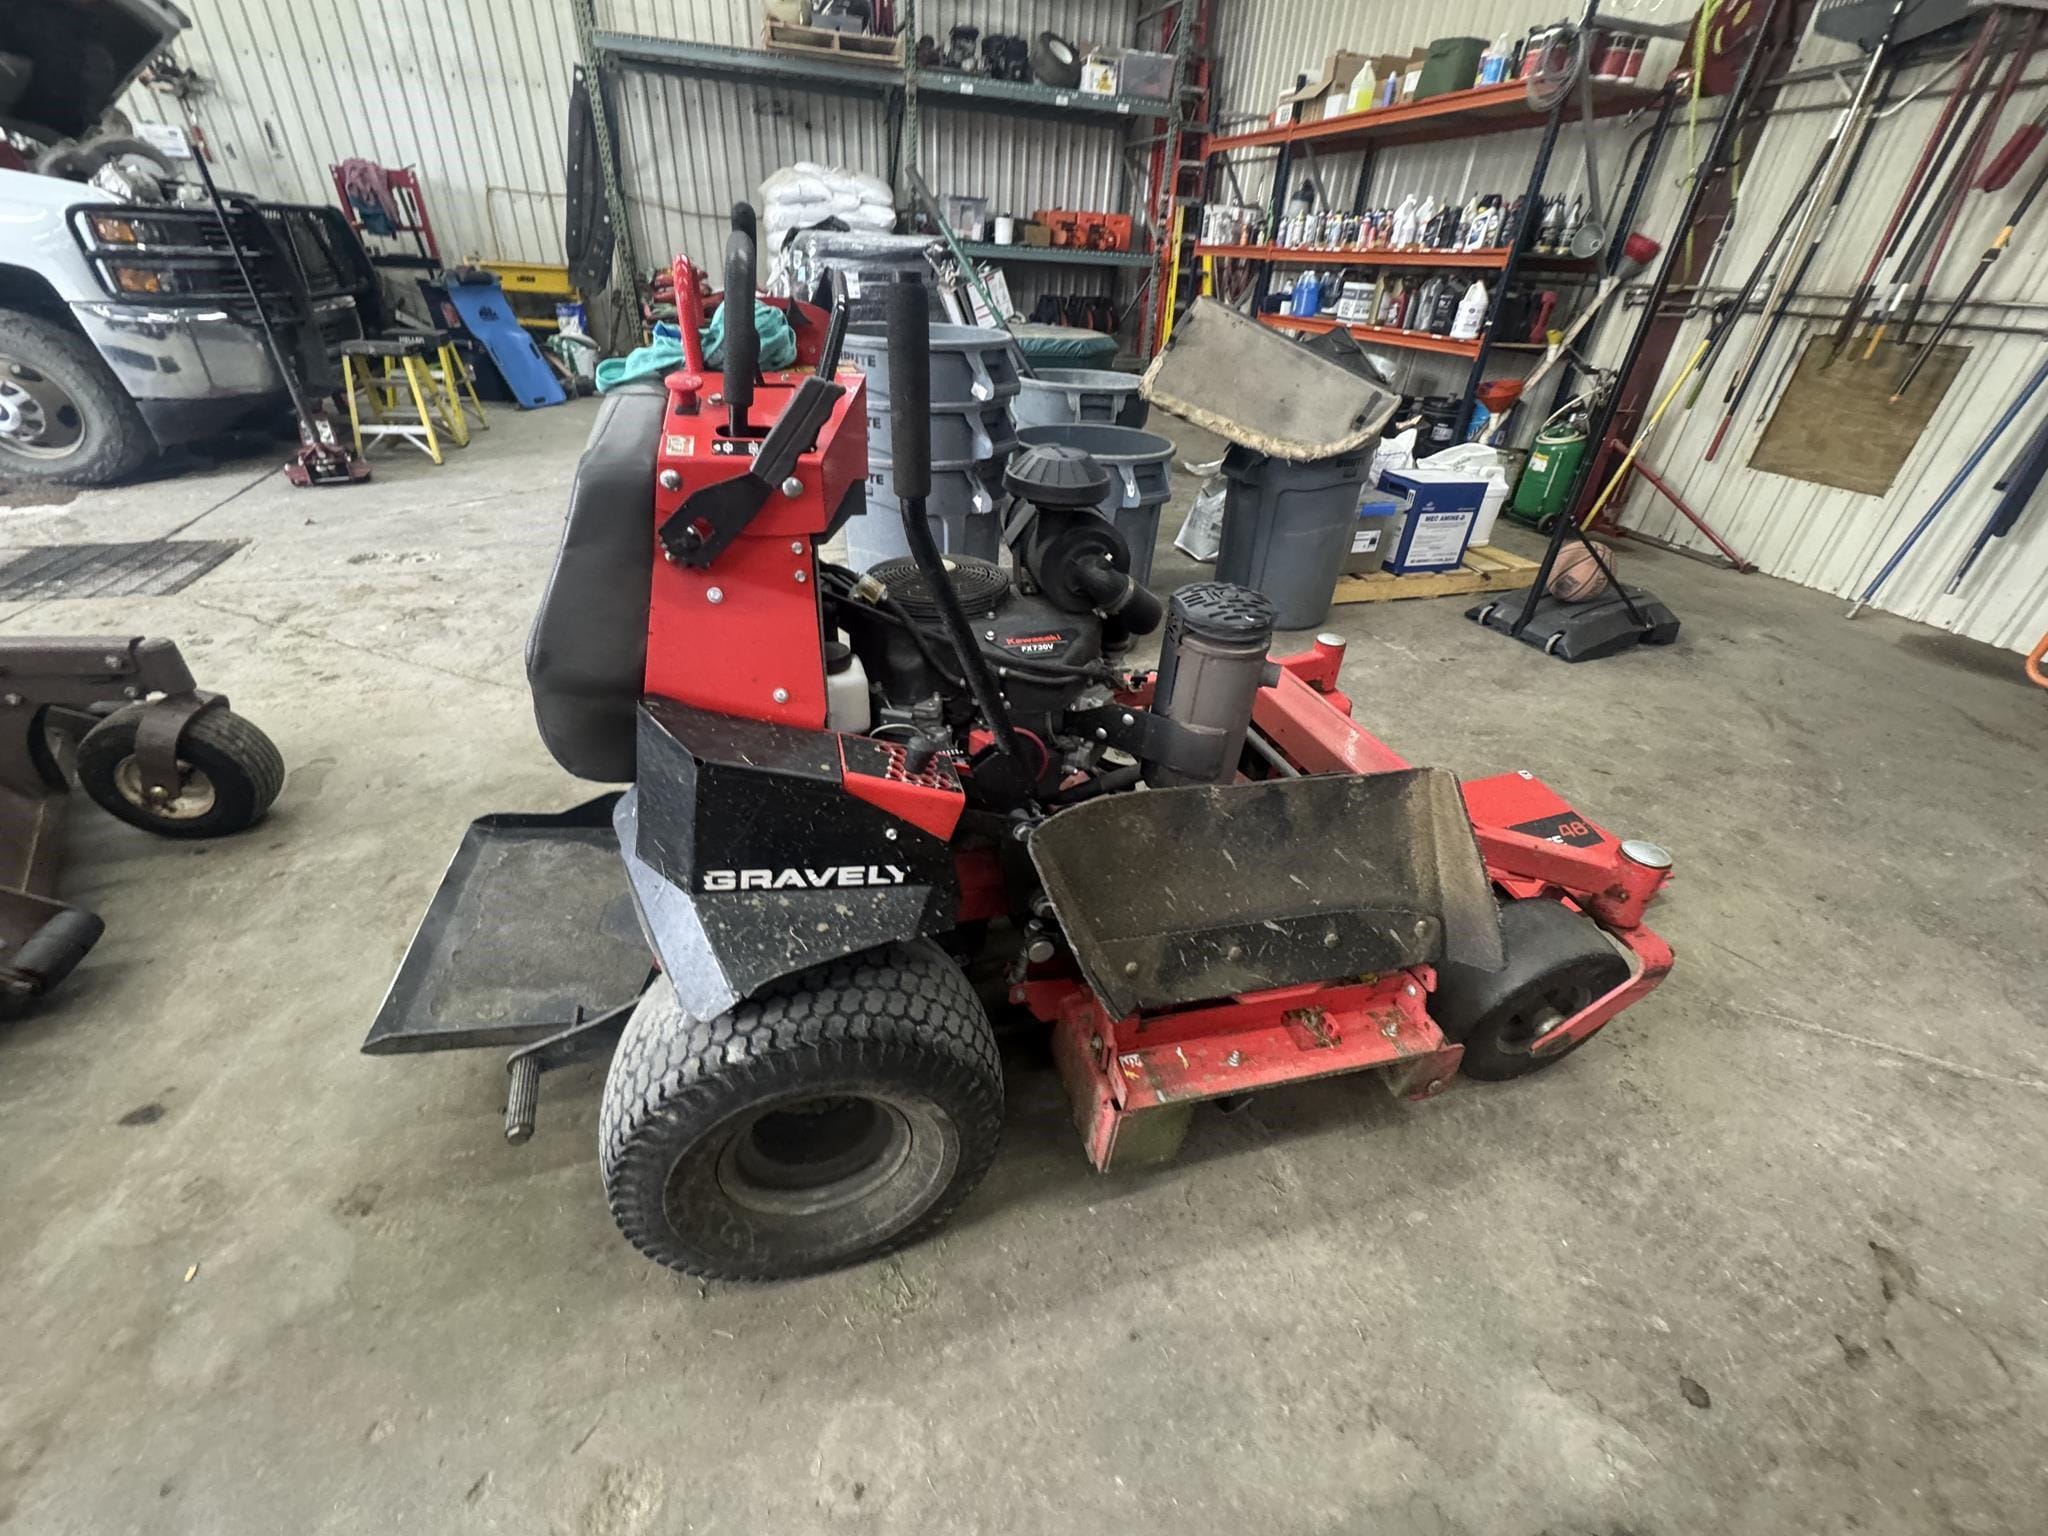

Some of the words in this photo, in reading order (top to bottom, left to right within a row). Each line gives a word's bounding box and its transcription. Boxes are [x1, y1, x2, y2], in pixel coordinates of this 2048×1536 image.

[840, 351, 876, 368] RUTE
[1021, 643, 1054, 652] FX730V
[703, 865, 906, 891] GRAVELY
